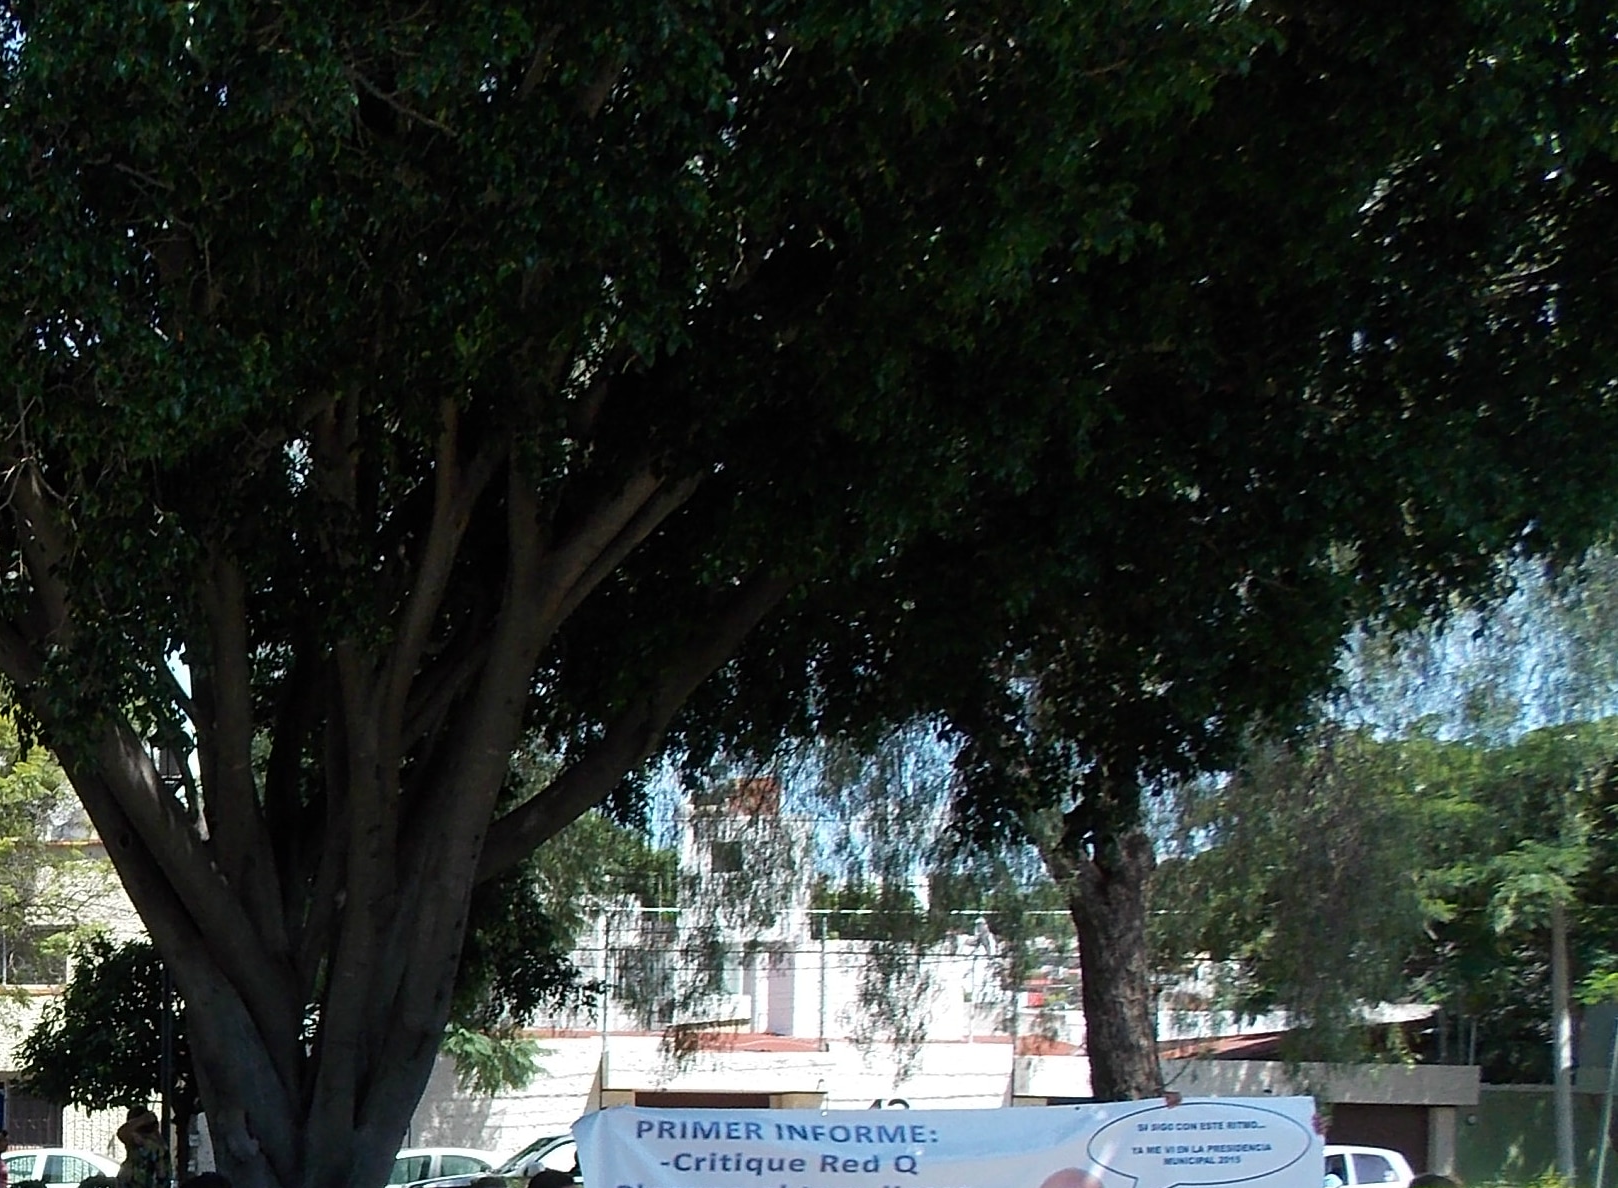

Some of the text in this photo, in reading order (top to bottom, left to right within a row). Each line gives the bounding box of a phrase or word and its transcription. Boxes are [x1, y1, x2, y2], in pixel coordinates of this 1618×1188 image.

[636, 1119, 939, 1144] PRIMER INFORME:
[1200, 1121, 1223, 1130] ESTE
[1191, 1145, 1204, 1154] LA
[1207, 1143, 1272, 1153] PRESIDENCIA
[660, 1152, 919, 1176] -Critique Red Q
